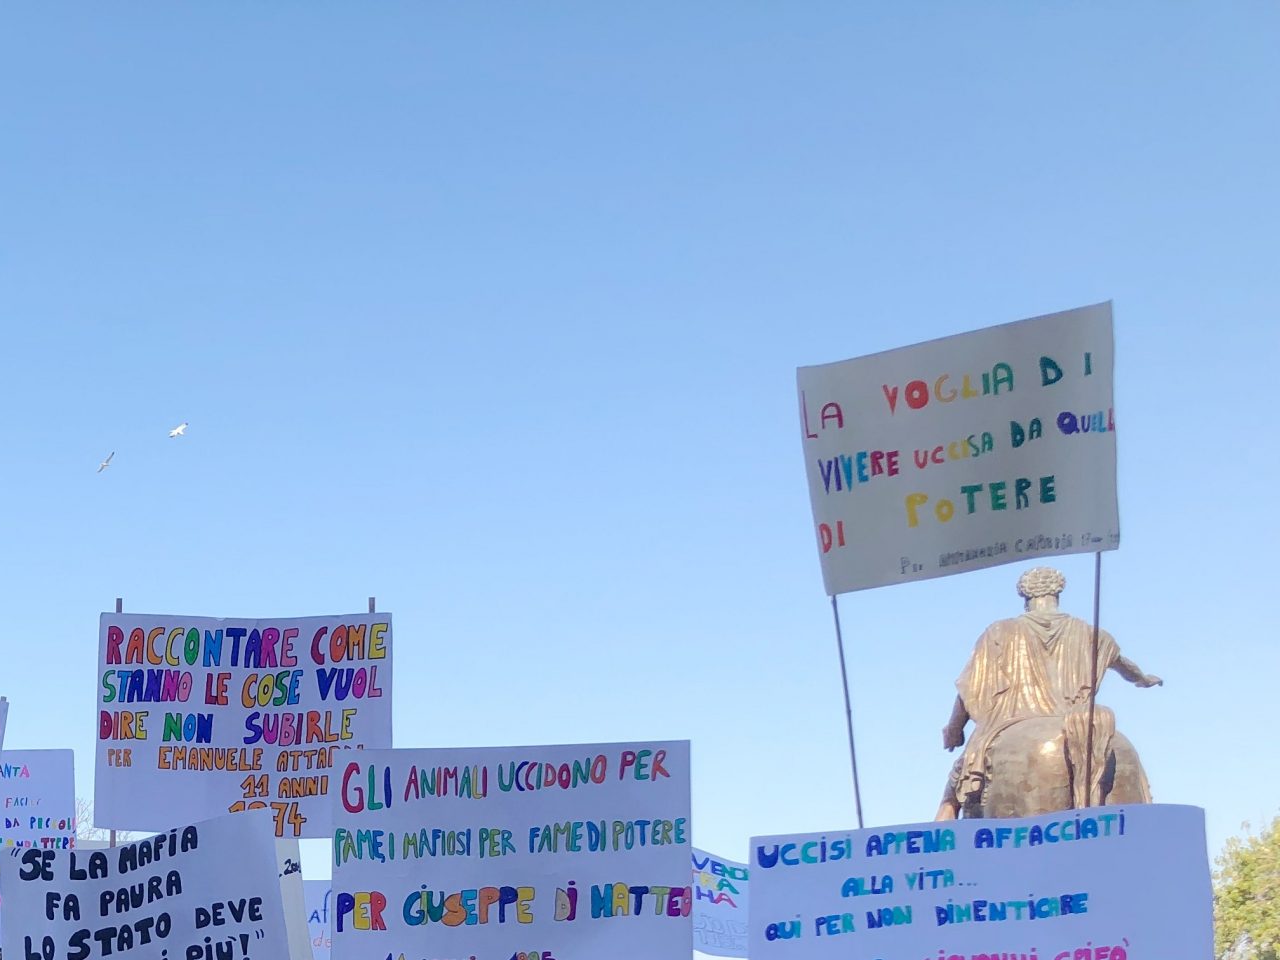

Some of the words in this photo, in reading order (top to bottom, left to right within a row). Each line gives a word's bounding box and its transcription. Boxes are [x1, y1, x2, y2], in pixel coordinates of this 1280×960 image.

[802, 390, 843, 438] LA
[883, 362, 1014, 416] VOGLIA
[819, 450, 900, 494] VIVERE
[1011, 417, 1042, 448] DA
[818, 521, 845, 553] DI
[905, 476, 1056, 528] POTERE
[107, 626, 299, 668] RACCONTARE
[310, 623, 388, 665] COME
[102, 669, 193, 703] STANNO
[205, 672, 231, 705] LE
[242, 669, 303, 708] COSE
[317, 666, 382, 700] VUOL
[100, 710, 148, 740] DIRE
[162, 712, 213, 743] NON
[244, 709, 357, 746] SUBIRLE
[108, 749, 132, 767] PER
[158, 746, 264, 771] EMANUELE
[342, 762, 392, 813] GLI
[405, 765, 487, 803] ANIMALI
[498, 754, 606, 793] UCCIDONO
[620, 749, 670, 782] PER
[241, 774, 269, 798] 11
[279, 775, 328, 798] ANNI
[70, 852, 108, 880] LA
[119, 826, 198, 874] MAFIA
[403, 828, 471, 859] MAFIOSI
[479, 828, 516, 858] PER
[529, 821, 582, 854] FAME
[587, 821, 606, 852] DI
[613, 818, 686, 850] POTERE
[757, 833, 852, 868] UCCISI
[866, 829, 956, 857] APPENA
[974, 810, 1124, 849] AFFACCIATI
[46, 892, 80, 920] FA
[100, 870, 182, 916] PAURA
[336, 891, 387, 933] PER
[403, 883, 535, 927] GIUSEPPE
[554, 880, 577, 921] DI
[591, 882, 692, 919] MATTEO
[842, 875, 893, 898] ALLA
[68, 912, 171, 960] STATO
[196, 897, 262, 929] DEVE
[765, 914, 801, 941] QUI
[816, 913, 855, 937] PER
[867, 906, 912, 929] NON
[935, 892, 1089, 926] DIMENTICARE
